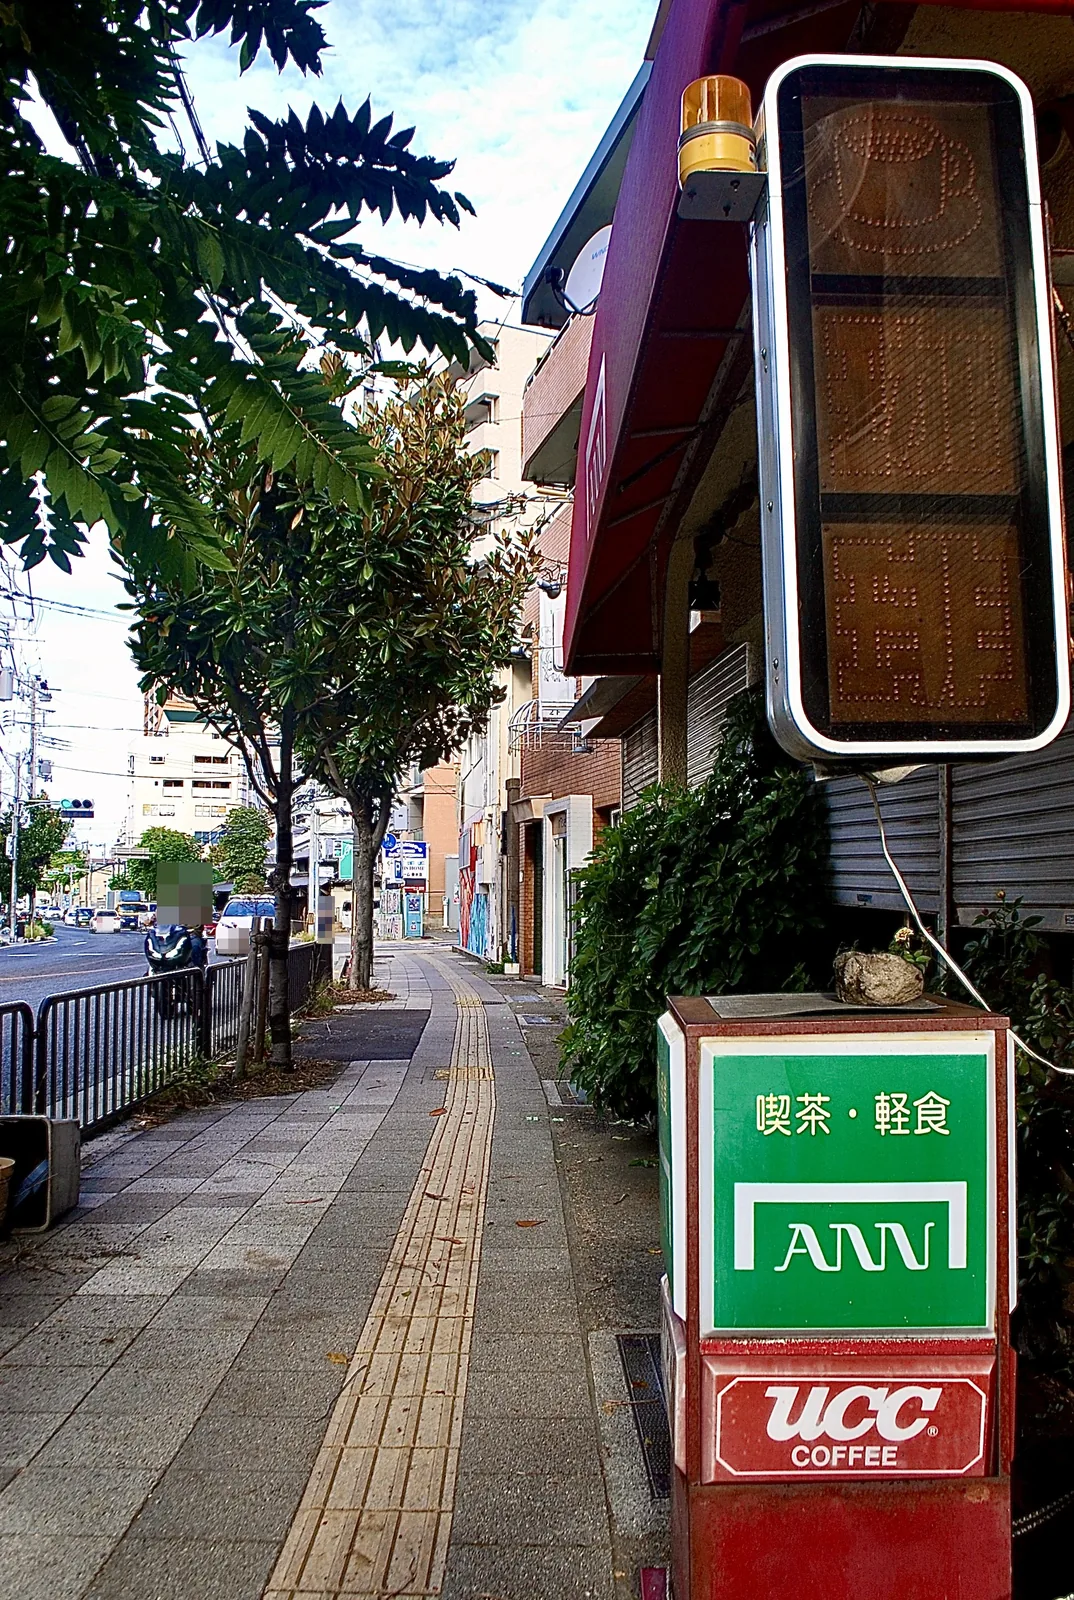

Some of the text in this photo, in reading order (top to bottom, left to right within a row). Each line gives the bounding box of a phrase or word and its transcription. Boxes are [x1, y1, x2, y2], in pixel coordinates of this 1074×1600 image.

[756, 1090, 951, 1136] 喫茶・軽食
[773, 1222, 935, 1271] ANN
[791, 1445, 899, 1467] COFFEE
